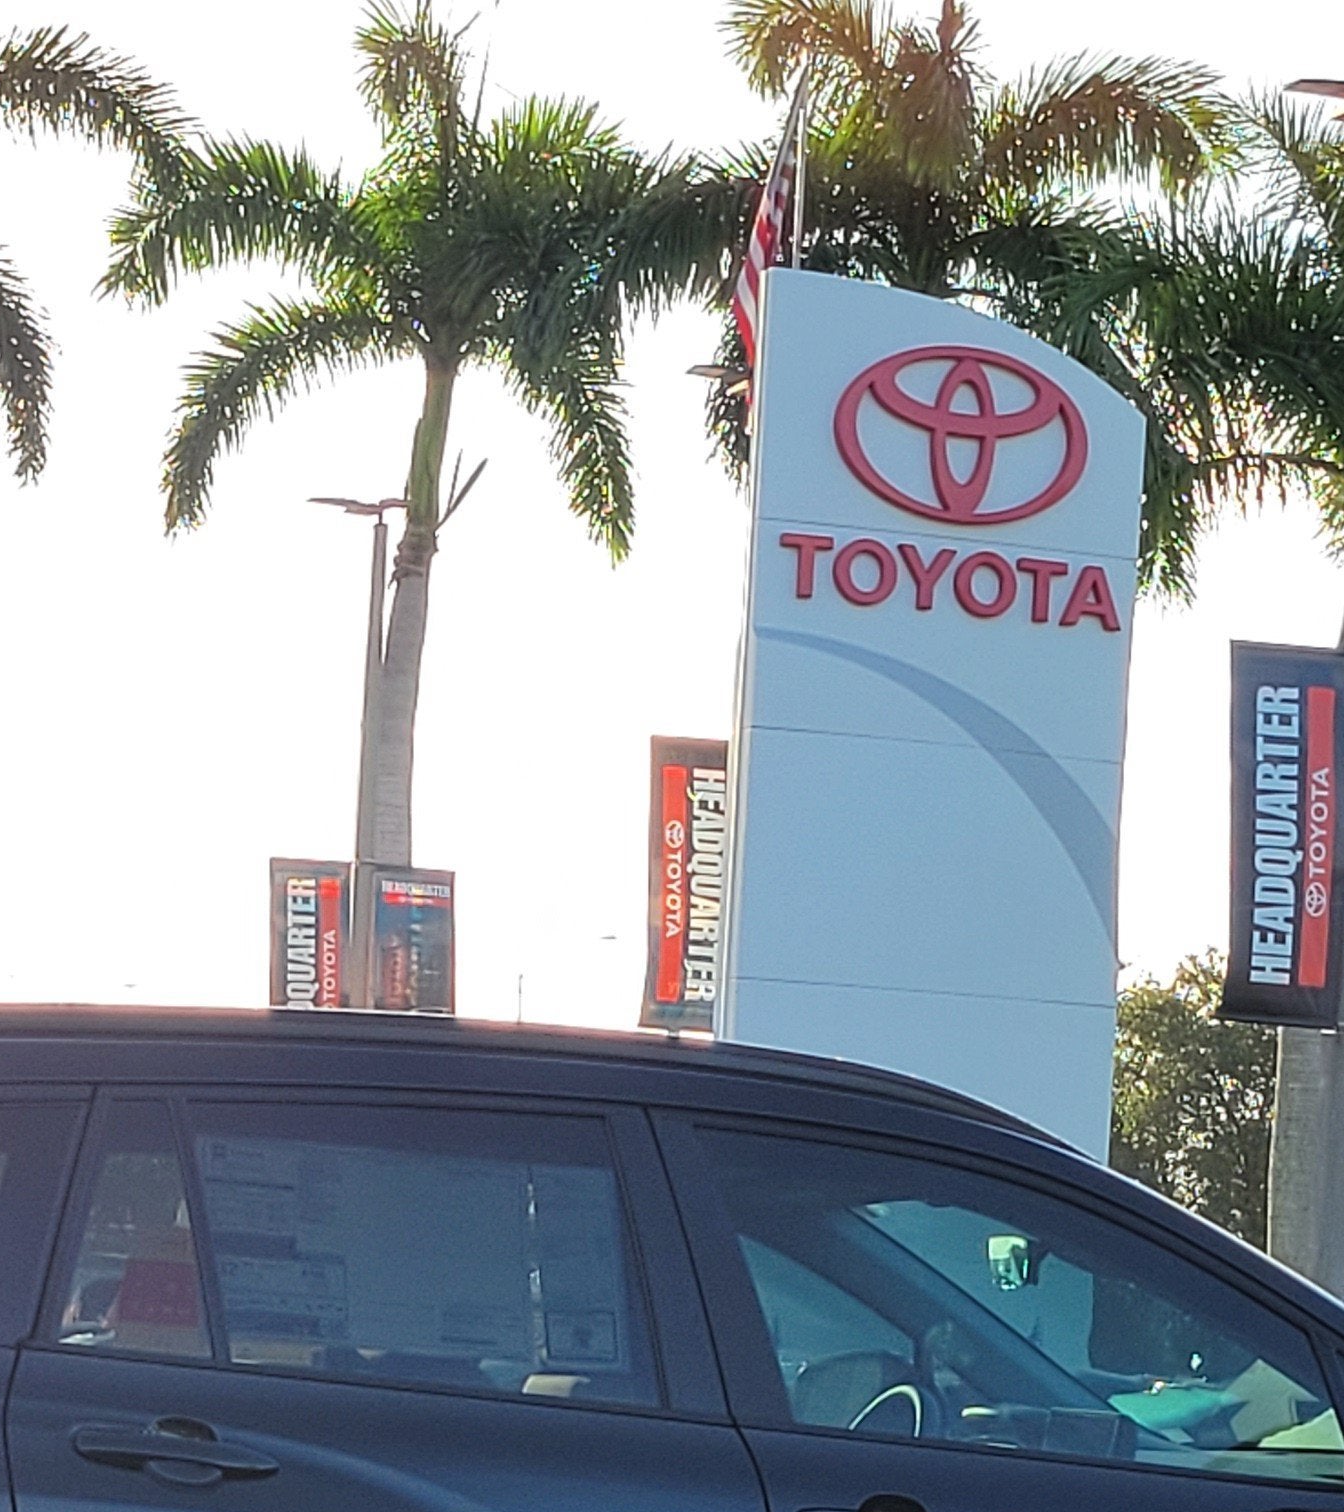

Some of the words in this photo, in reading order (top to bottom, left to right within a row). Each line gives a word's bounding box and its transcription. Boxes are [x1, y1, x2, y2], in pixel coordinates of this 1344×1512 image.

[779, 532, 1121, 632] TOYOTA
[1249, 685, 1303, 986] HEADQUARTER
[1308, 767, 1330, 879] TOYOTA
[665, 850, 683, 939] TOYOTA
[684, 767, 726, 1001] HEADQUARTER
[286, 878, 319, 1010] QUARTER
[322, 929, 337, 1001] TOYOTA
